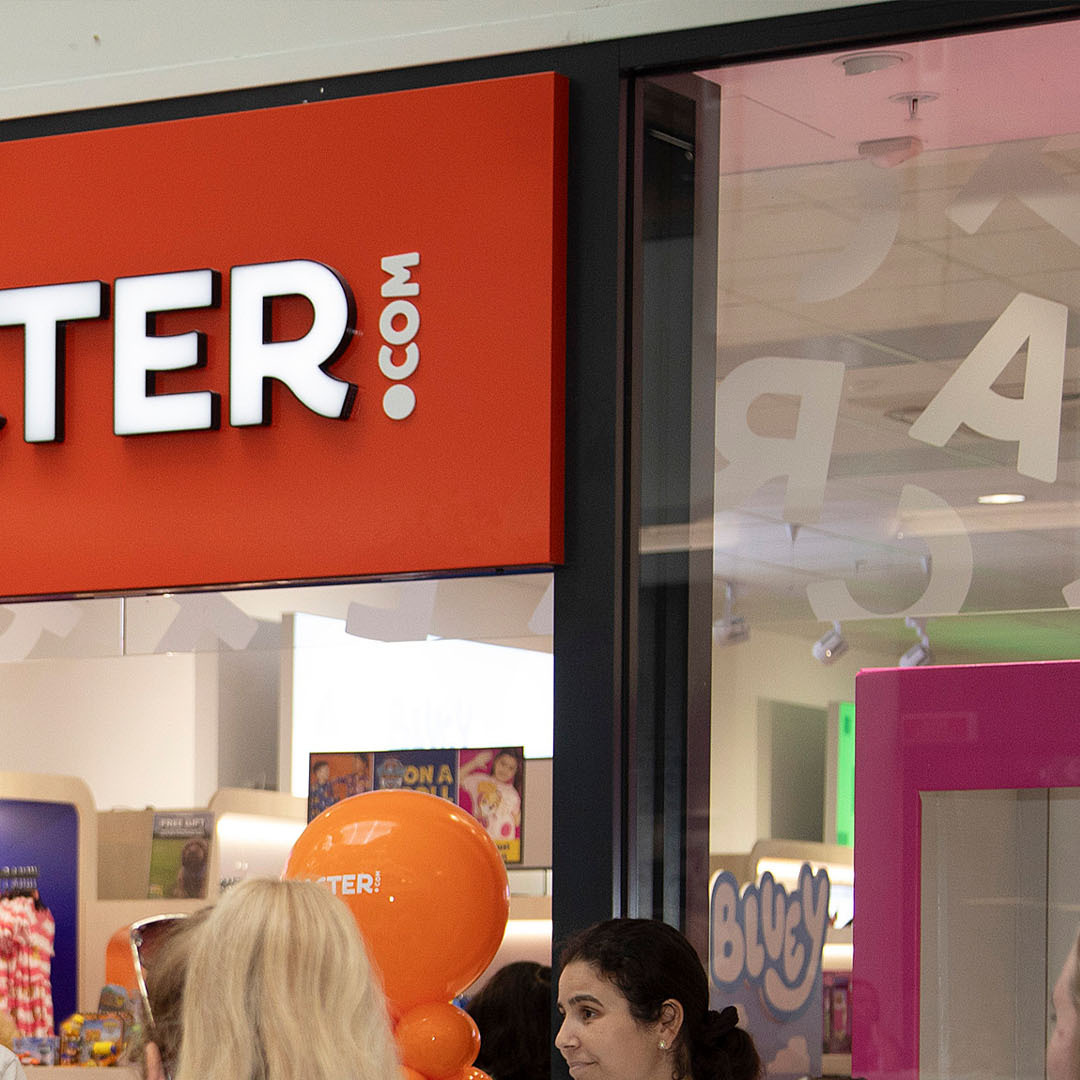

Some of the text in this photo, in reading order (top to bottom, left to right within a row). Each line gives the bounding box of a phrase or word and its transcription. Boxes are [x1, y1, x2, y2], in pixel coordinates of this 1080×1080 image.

[378, 251, 420, 420] .COM
[403, 765, 435, 784] ON
[438, 764, 454, 785] A
